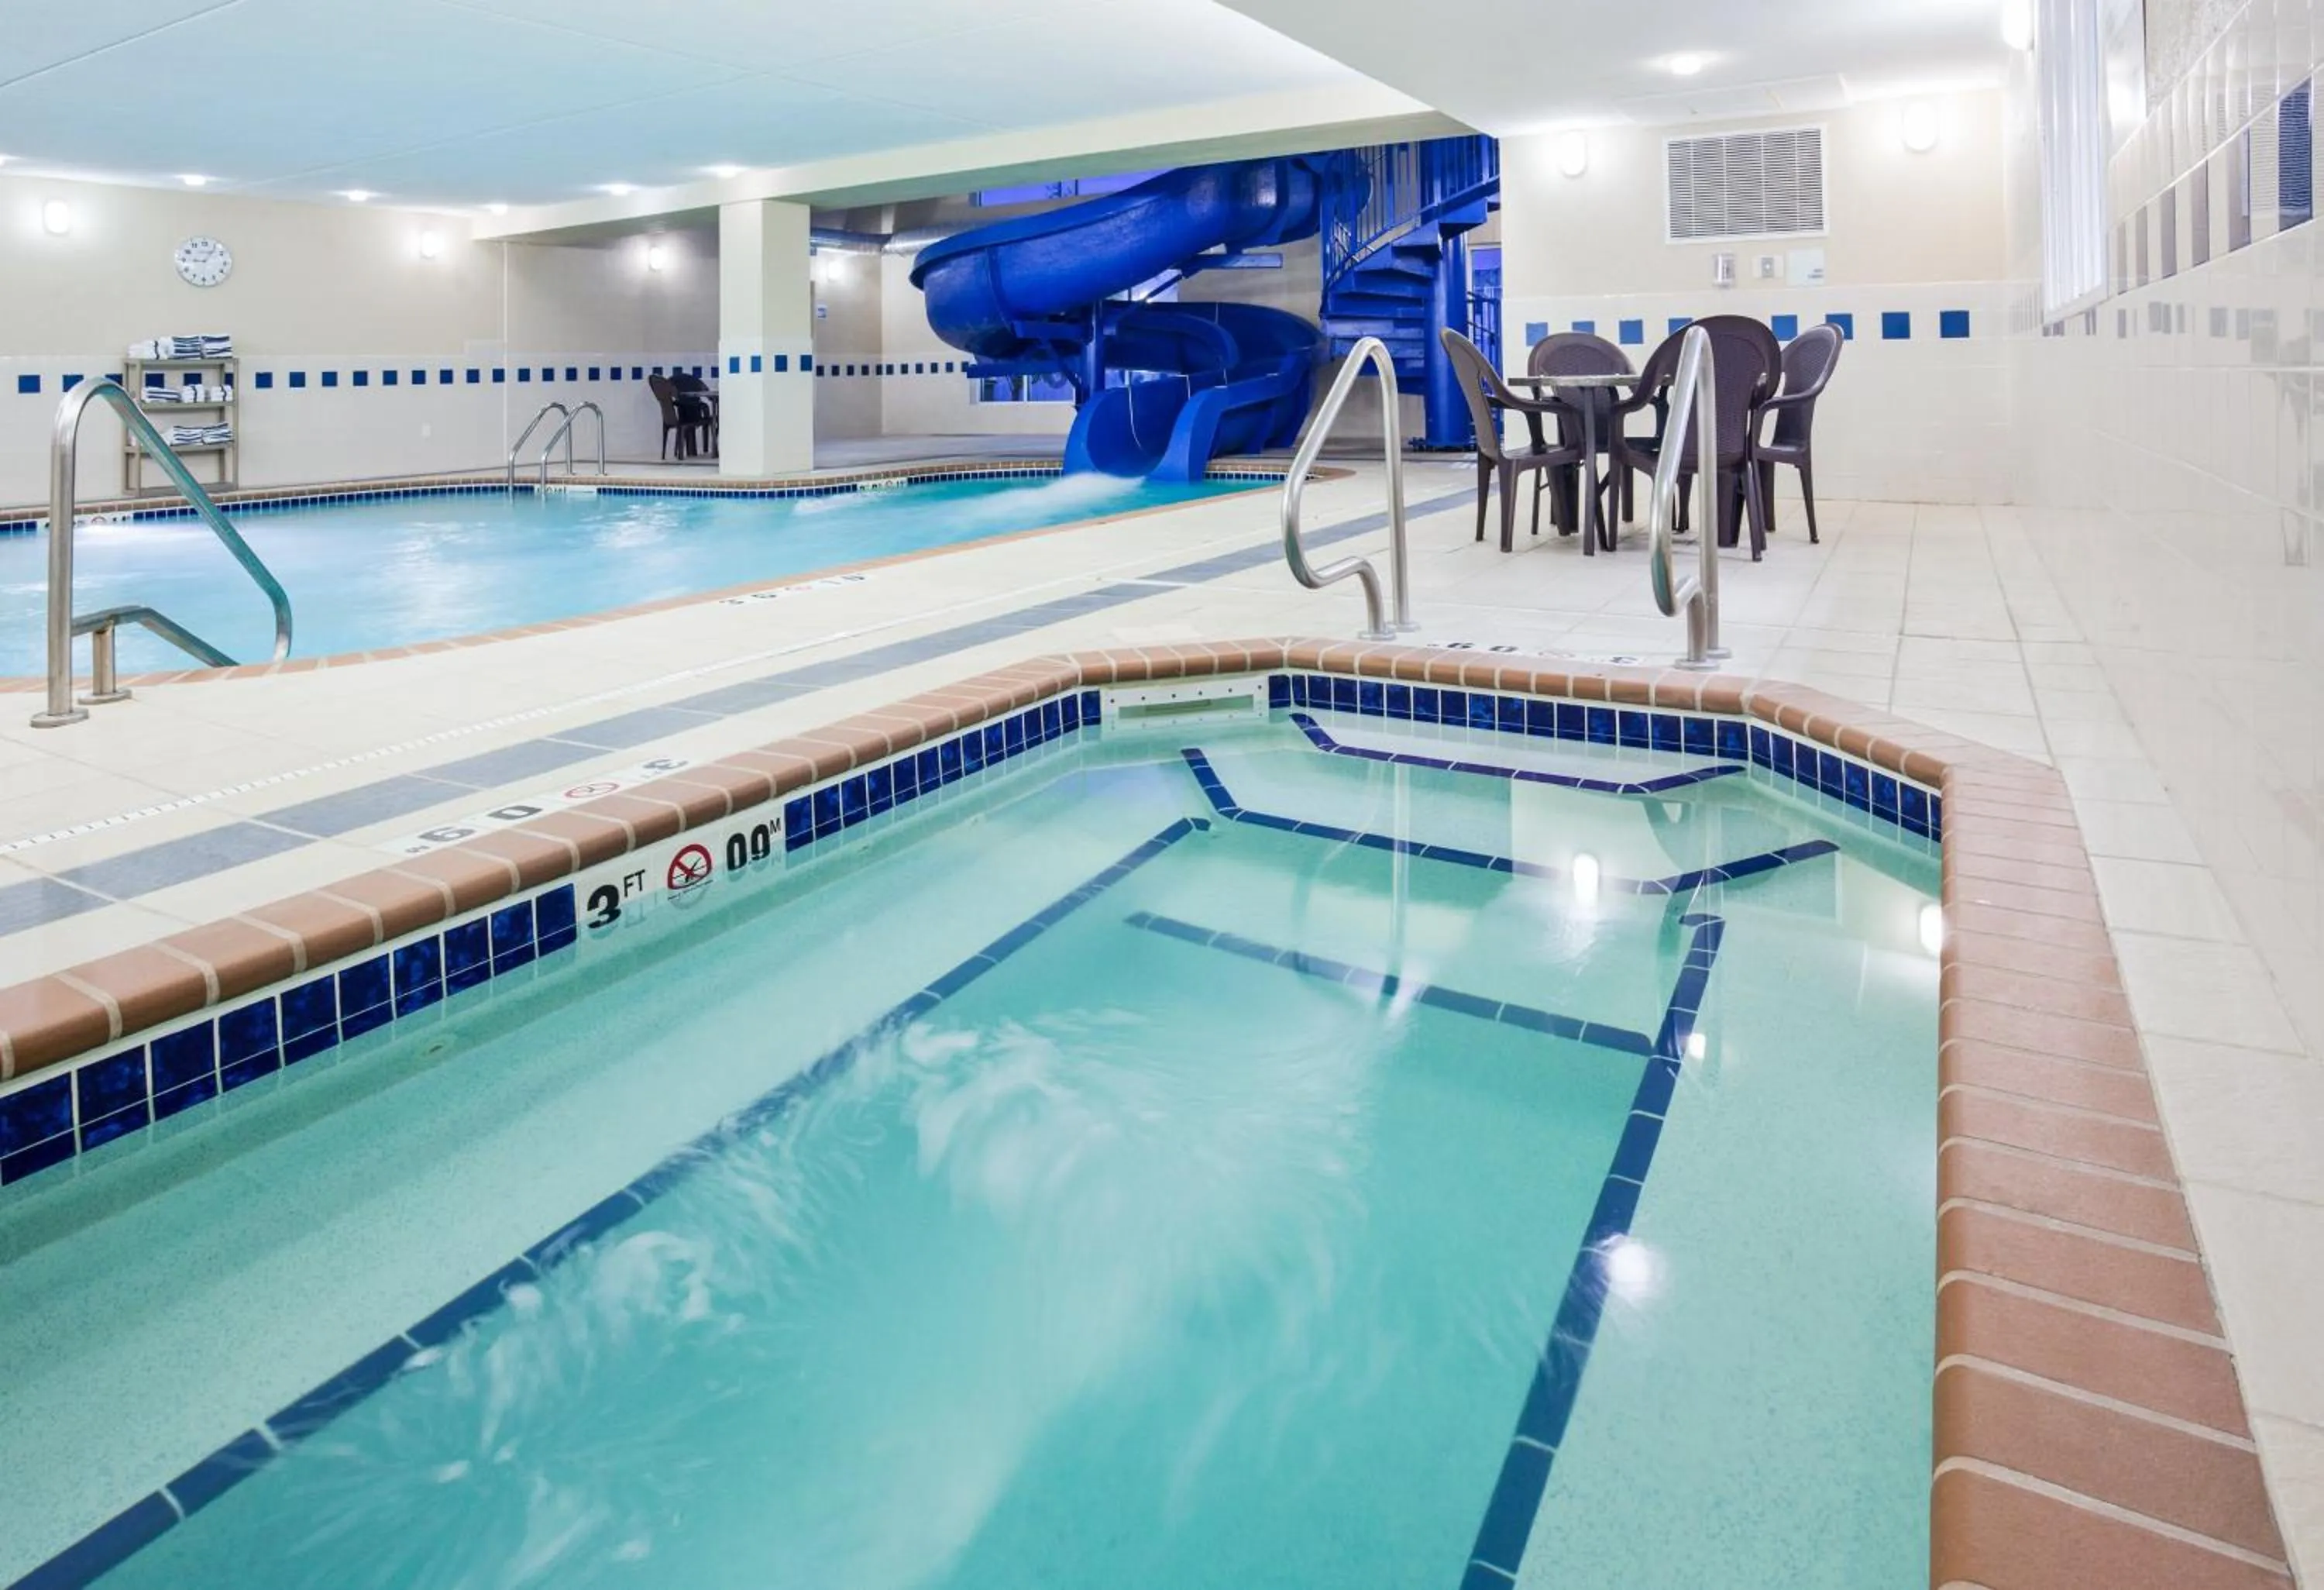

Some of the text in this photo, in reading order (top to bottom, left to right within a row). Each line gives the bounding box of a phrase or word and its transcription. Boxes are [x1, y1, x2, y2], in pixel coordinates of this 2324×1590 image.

[586, 884, 622, 928] 3
[624, 869, 645, 898] FT
[769, 817, 782, 835] M
